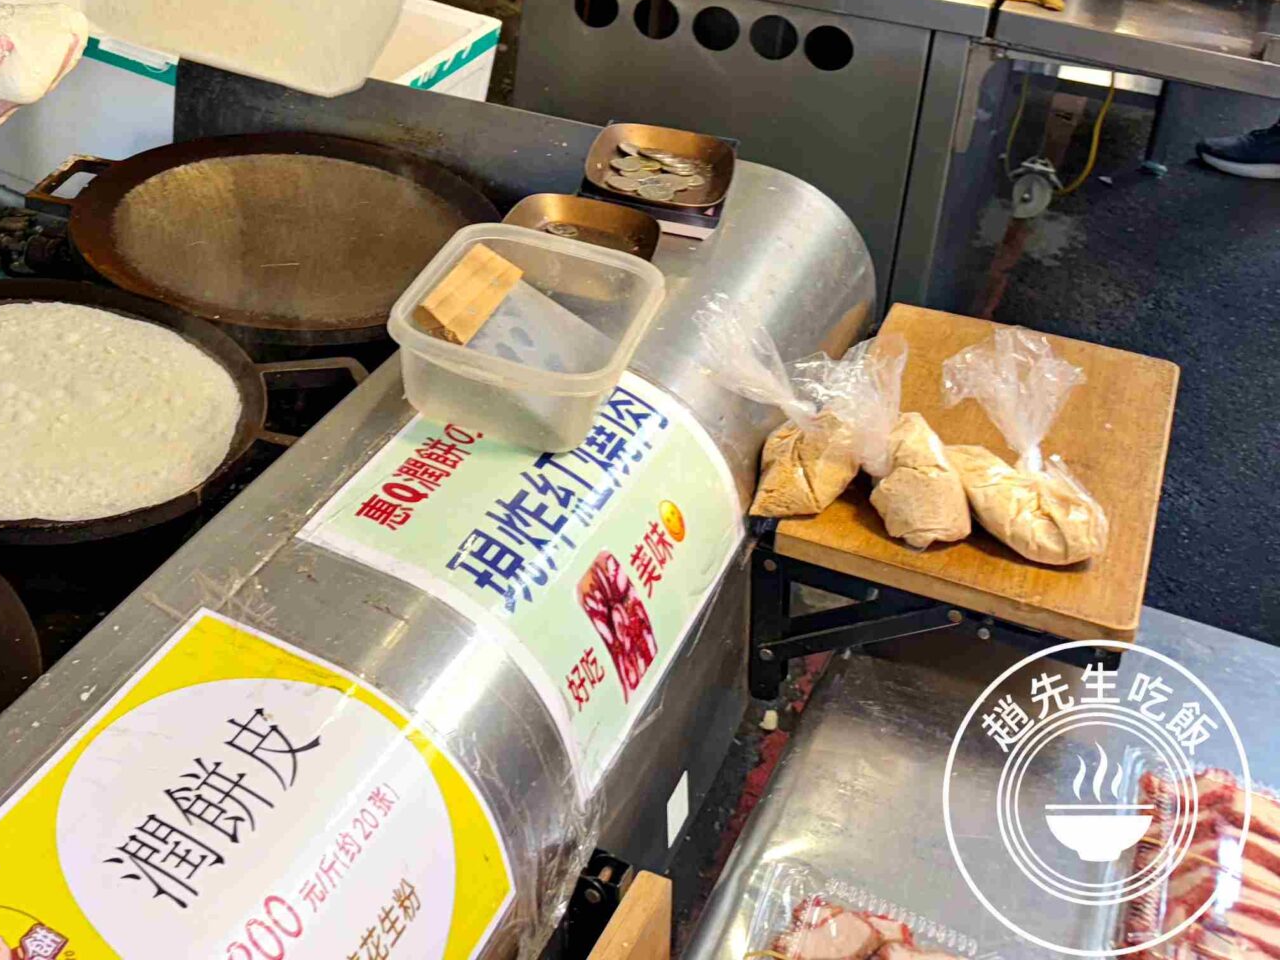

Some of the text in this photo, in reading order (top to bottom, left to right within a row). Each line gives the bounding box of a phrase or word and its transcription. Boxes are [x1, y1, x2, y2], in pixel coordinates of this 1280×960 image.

[446, 386, 669, 614] 現炸紅燒肉
[629, 521, 677, 599] 美味
[566, 647, 605, 712] 好吃
[102, 708, 320, 908] 潤餅皮
[346, 878, 421, 960] 花生粉
